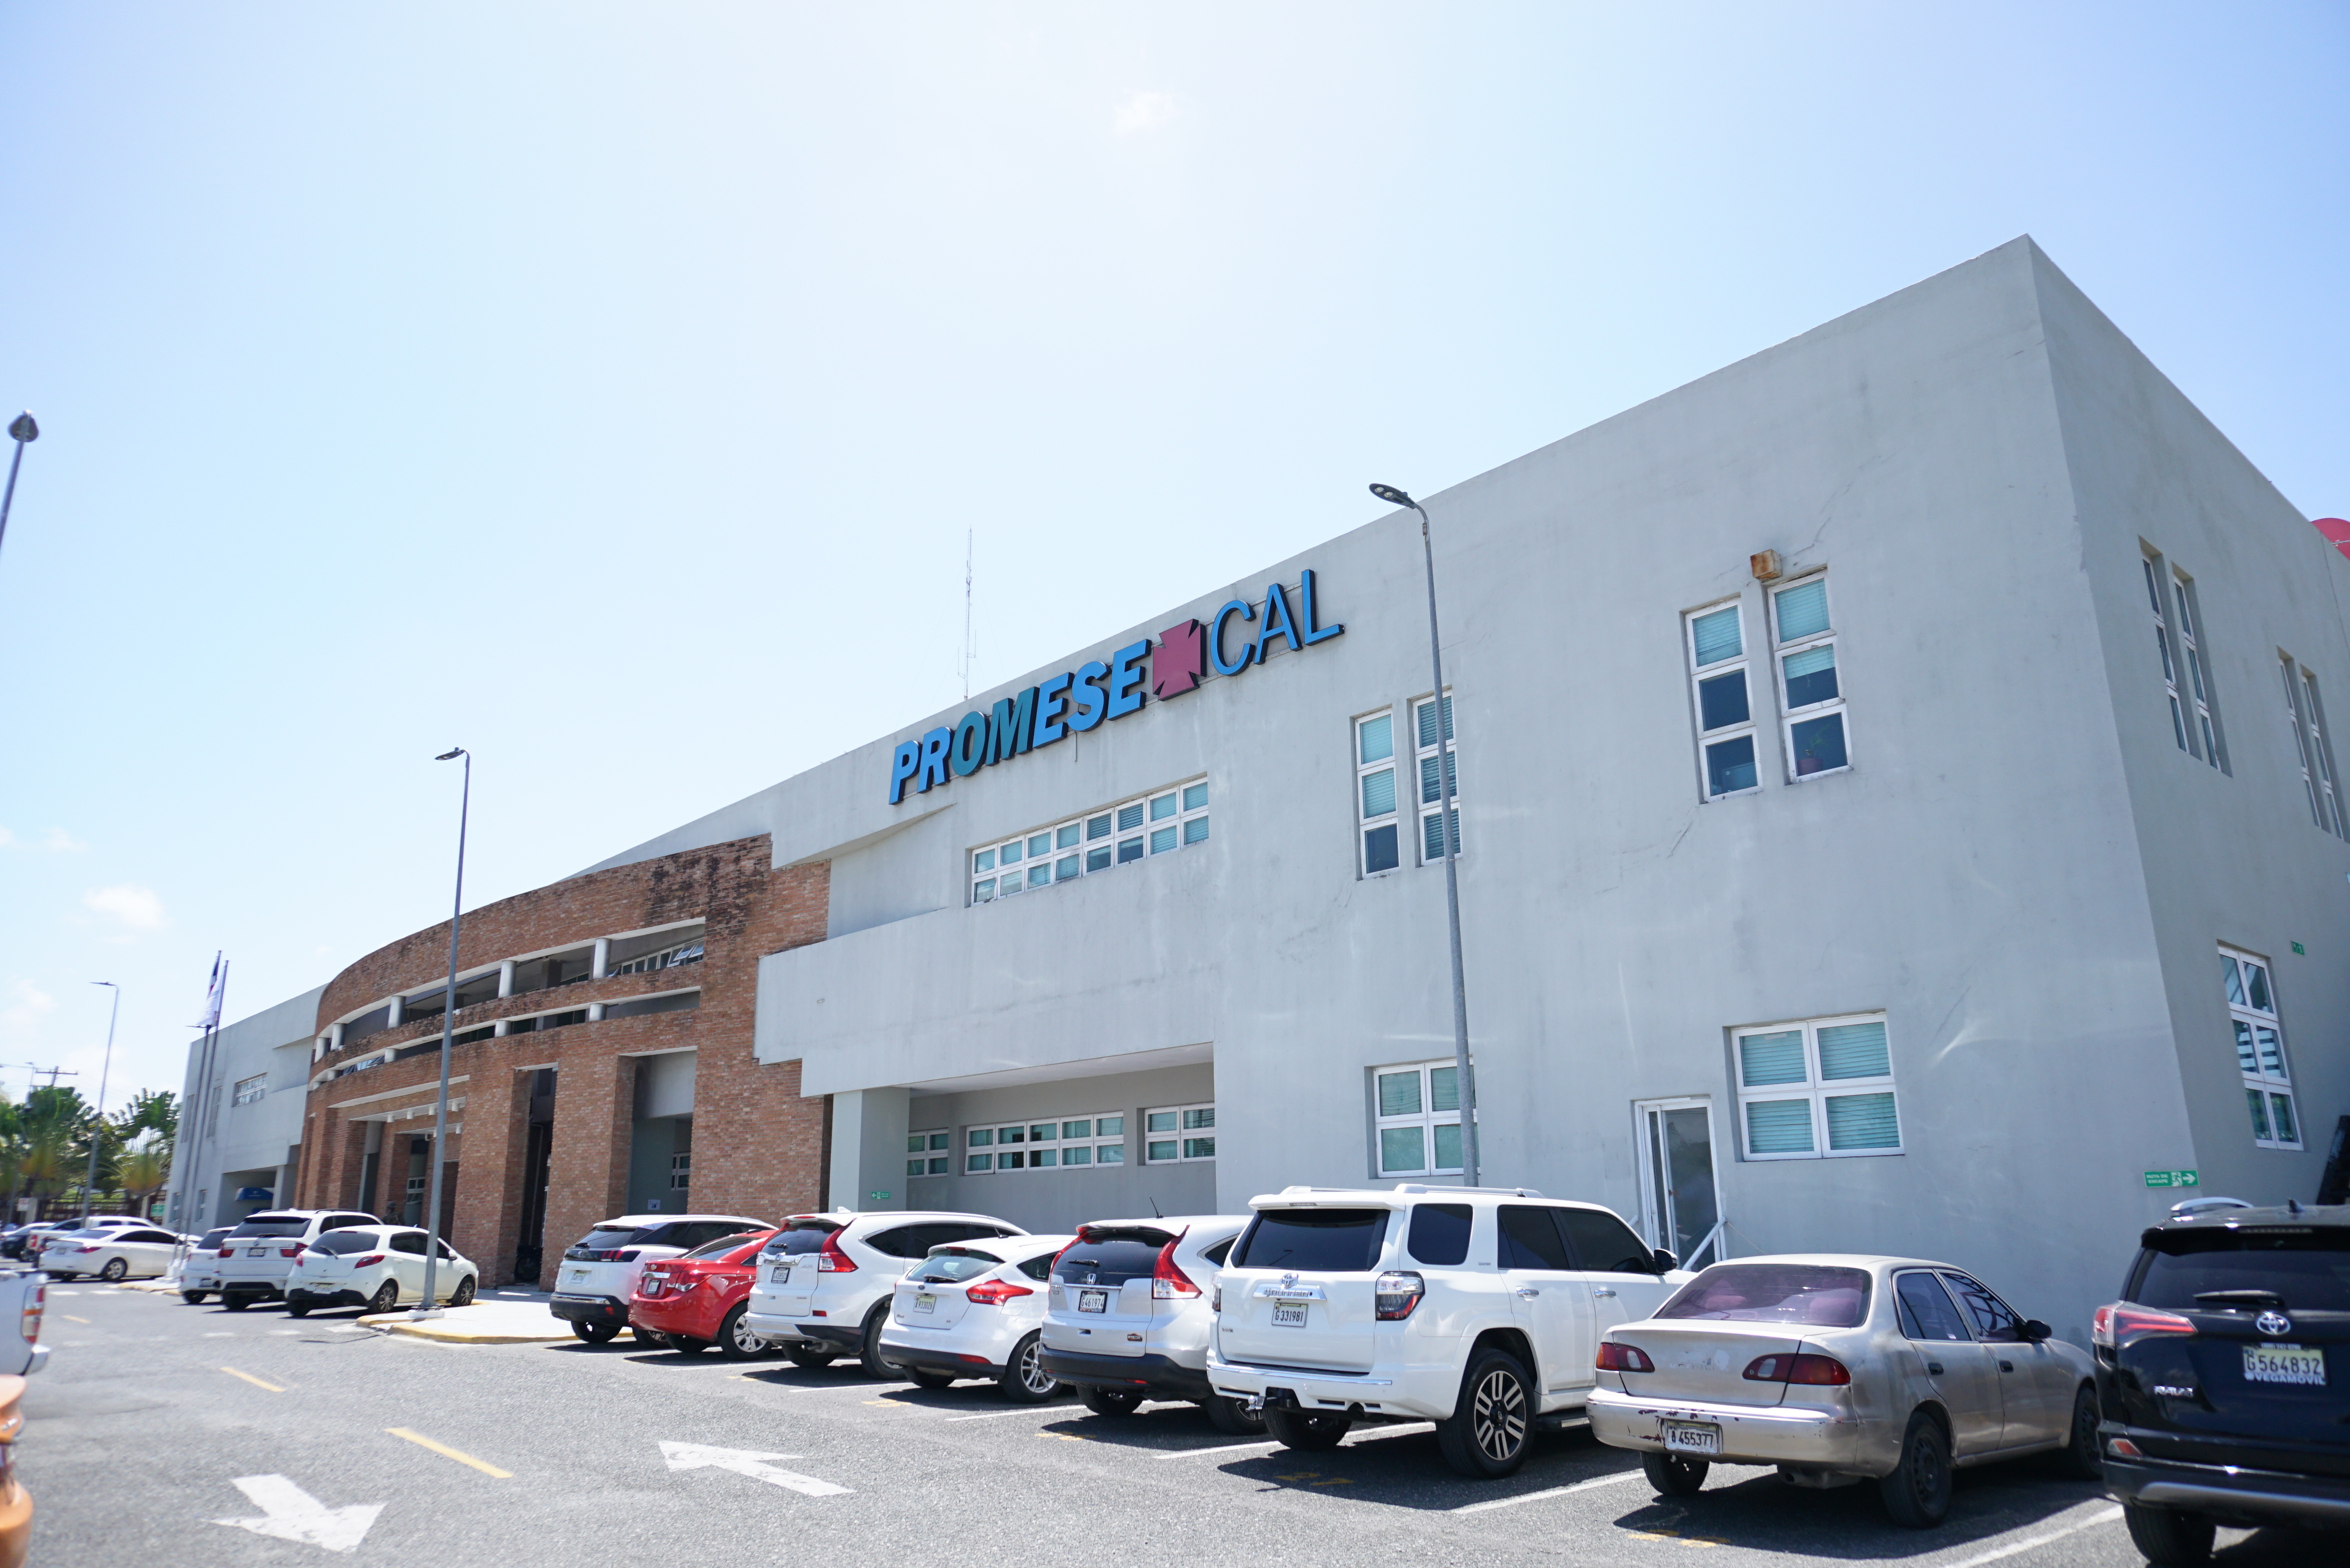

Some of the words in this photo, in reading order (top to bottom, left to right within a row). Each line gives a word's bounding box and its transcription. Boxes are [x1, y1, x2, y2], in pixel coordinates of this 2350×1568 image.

[889, 638, 1152, 805] PROMESE
[1210, 568, 1345, 677] CAL
[2247, 1354, 2321, 1375] G564832
